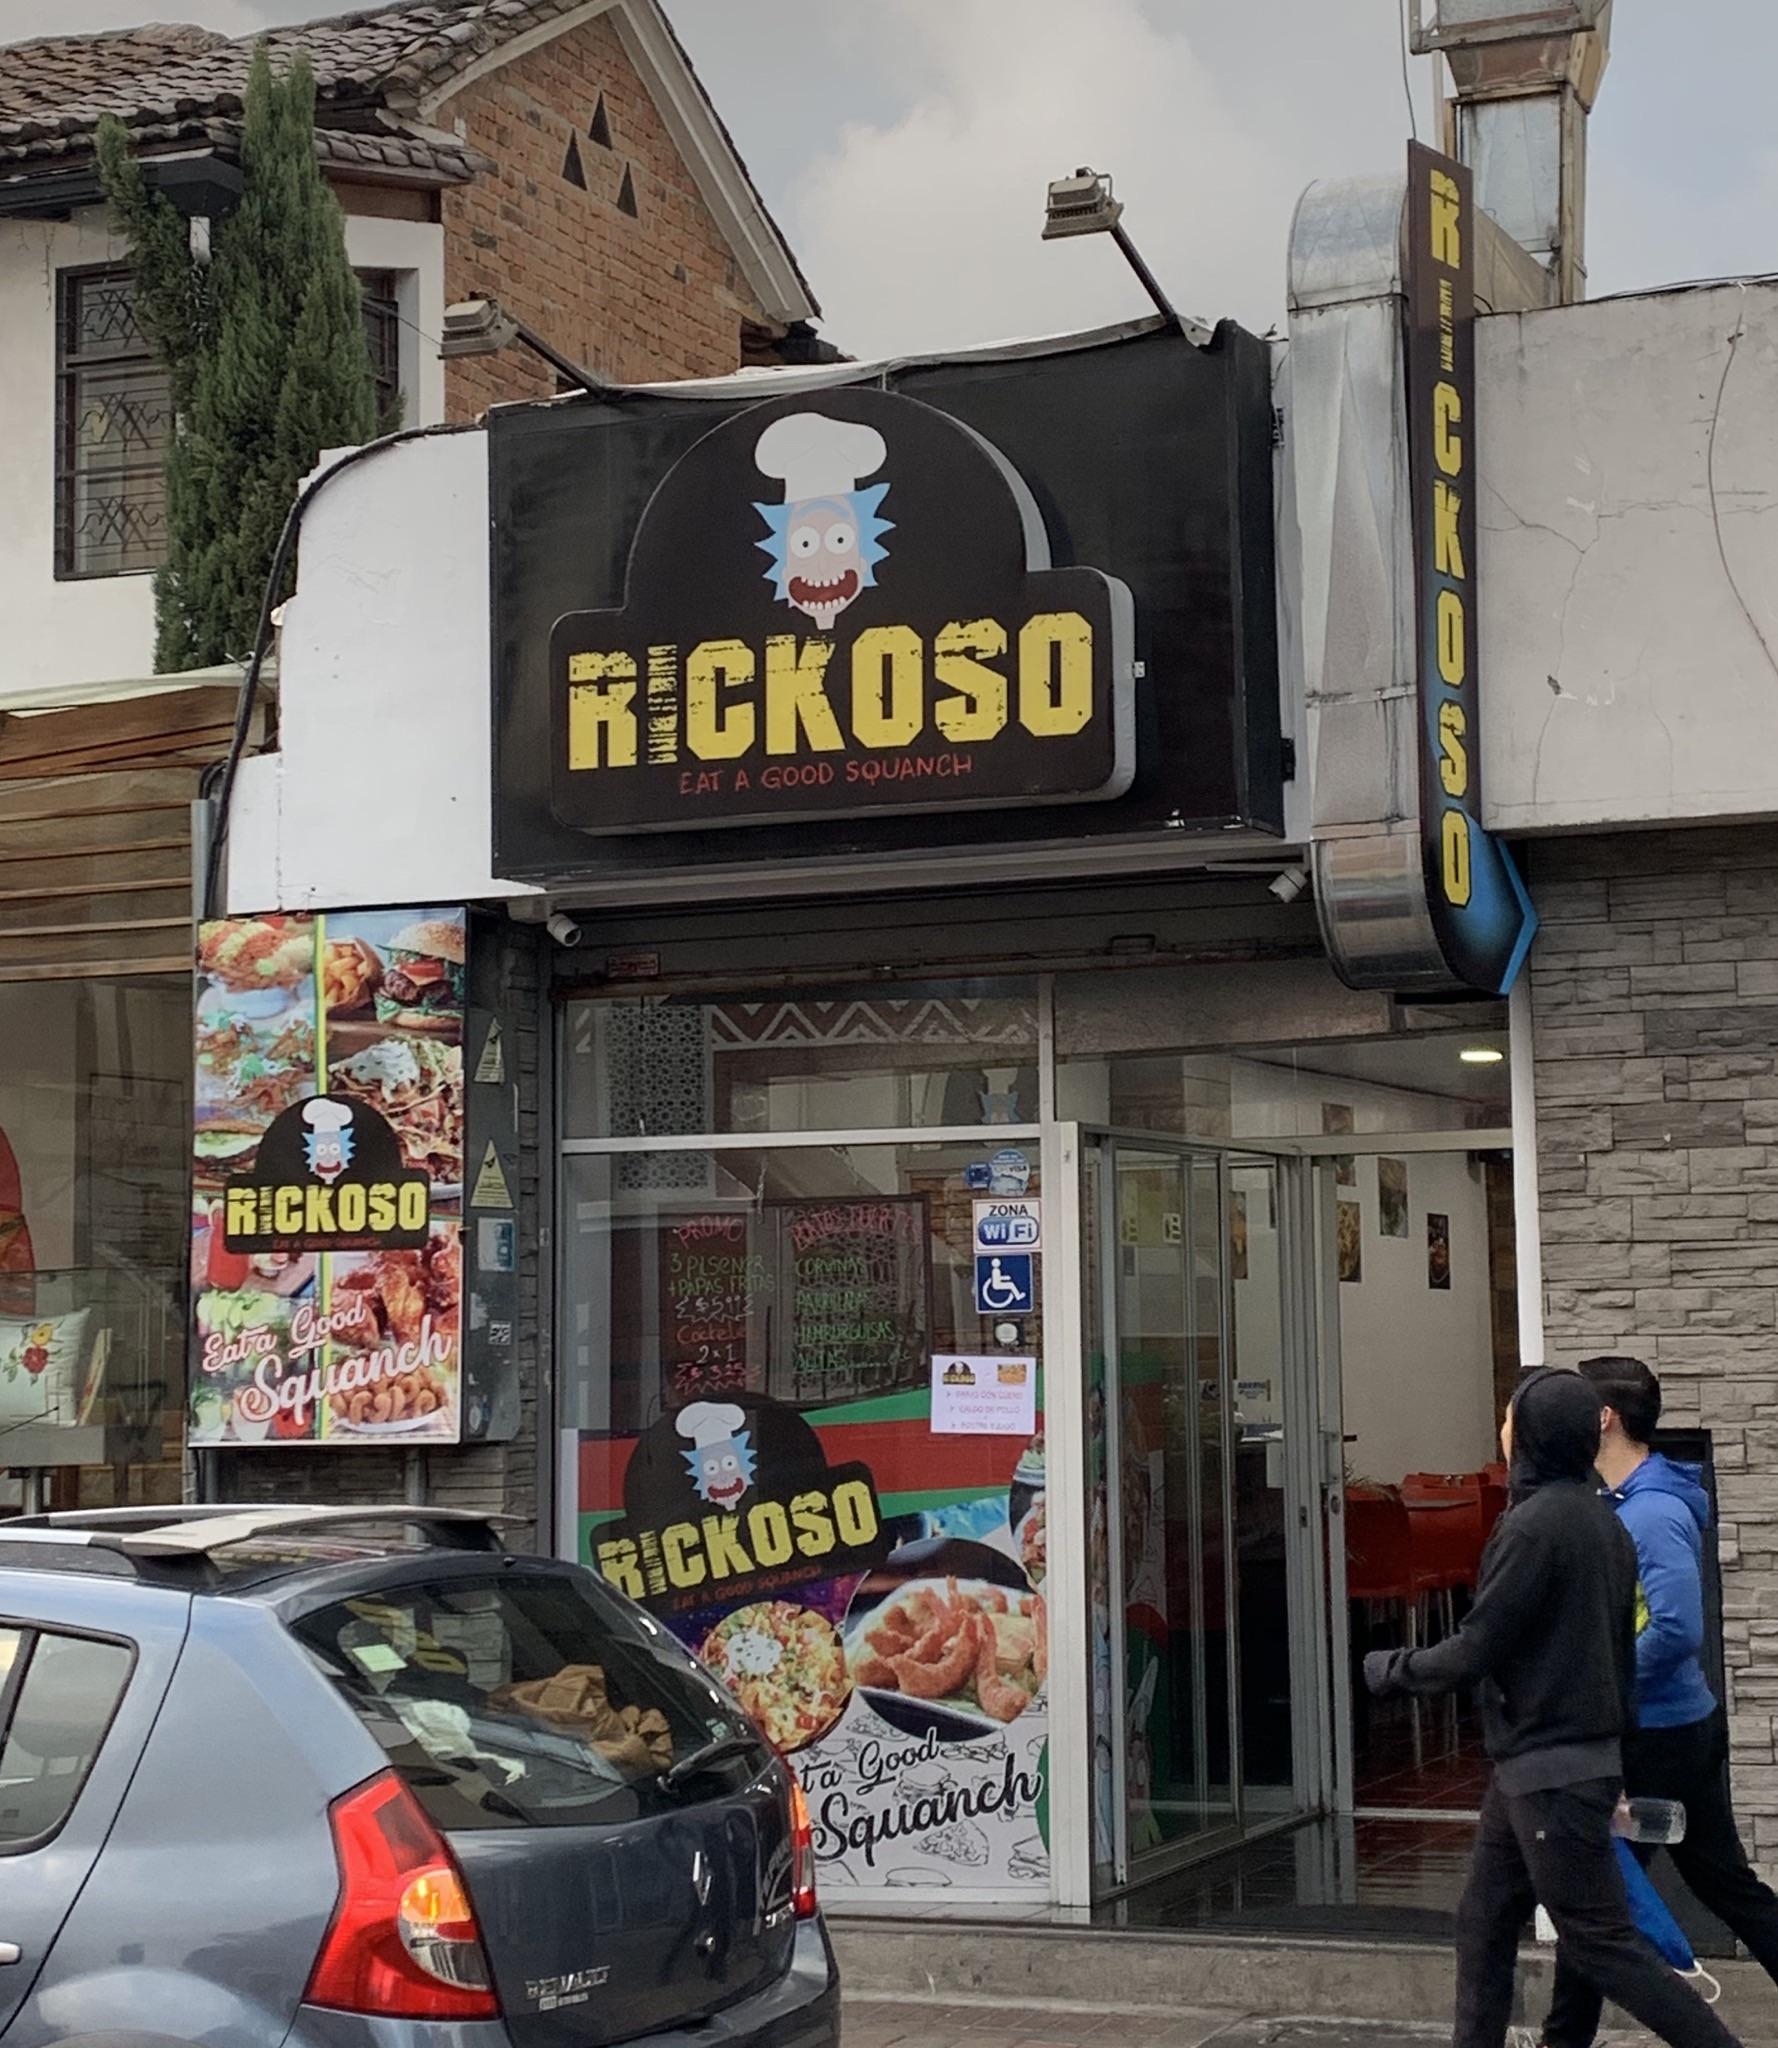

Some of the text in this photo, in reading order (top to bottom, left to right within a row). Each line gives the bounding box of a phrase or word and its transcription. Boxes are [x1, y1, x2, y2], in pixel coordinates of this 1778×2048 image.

[1430, 169, 1470, 906] RICKOSO
[568, 611, 1093, 771] RICKOSO
[680, 753, 972, 795] EAT A GOOD SQUANCH
[227, 1181, 427, 1236] RICKOSO
[675, 1216, 744, 1249] PROMO
[989, 1204, 1028, 1217] ZONA
[671, 1253, 682, 1273] 3
[288, 1295, 366, 1360] Good
[240, 1314, 452, 1426] Squanch
[598, 1480, 878, 1600] RICKOSO
[819, 1769, 842, 1788] a
[856, 1727, 940, 1796] Good
[812, 1752, 1041, 1867] Squanch
